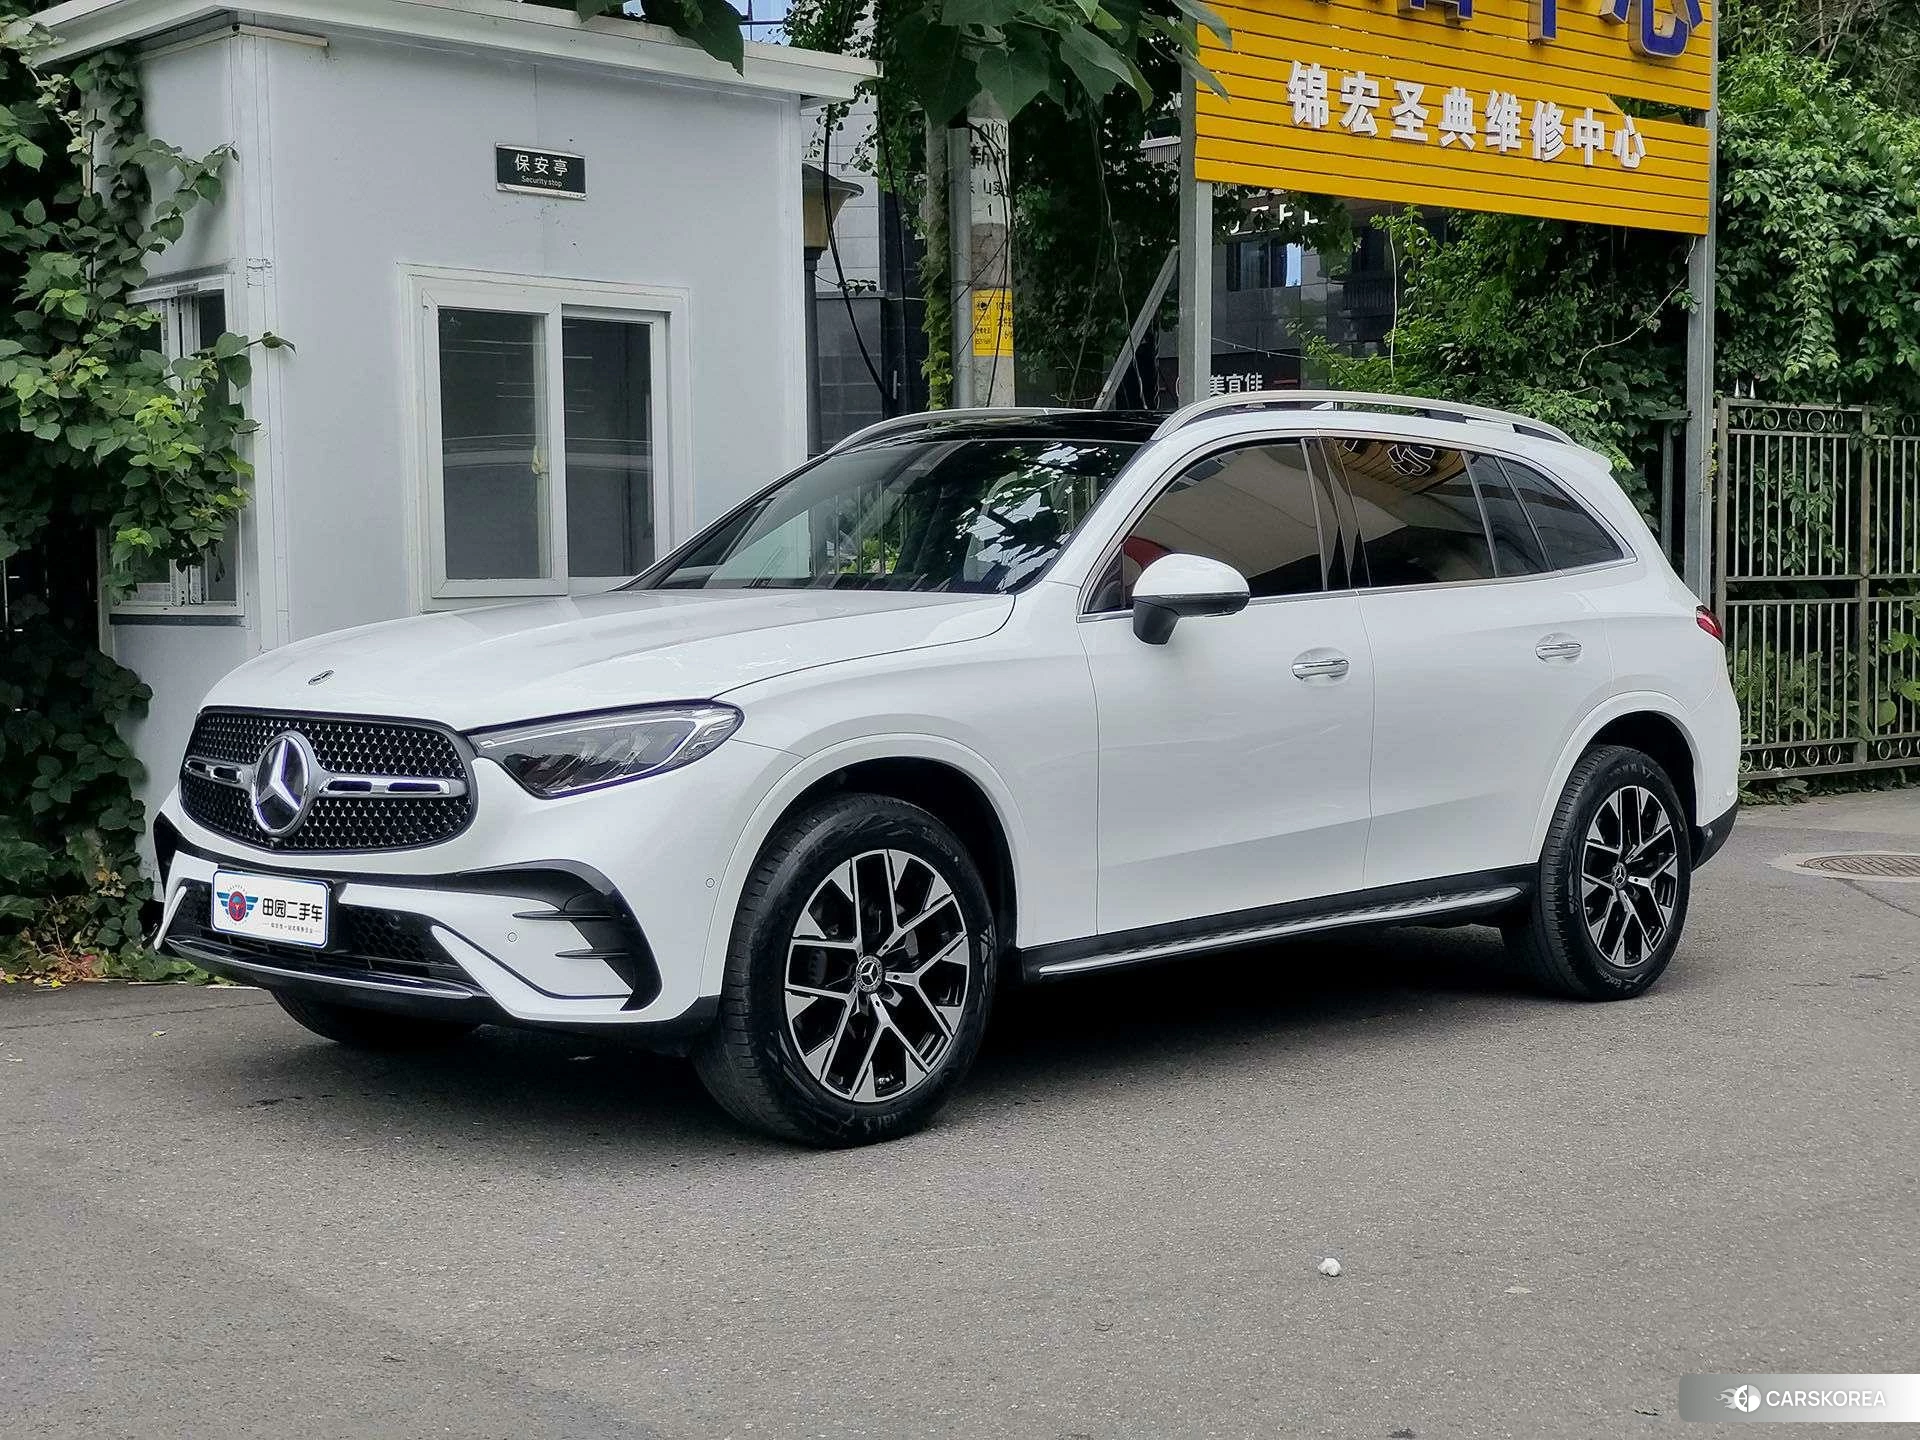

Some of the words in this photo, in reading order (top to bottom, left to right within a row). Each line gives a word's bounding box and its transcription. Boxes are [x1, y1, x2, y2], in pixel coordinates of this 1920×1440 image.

[1288, 60, 1646, 170] 锦宏圣典维修中心
[514, 153, 568, 176] 保安亭
[521, 175, 547, 186] Security
[548, 179, 563, 188] stop
[1208, 372, 1263, 397] 美宜佳
[262, 898, 323, 922] 田园二手车
